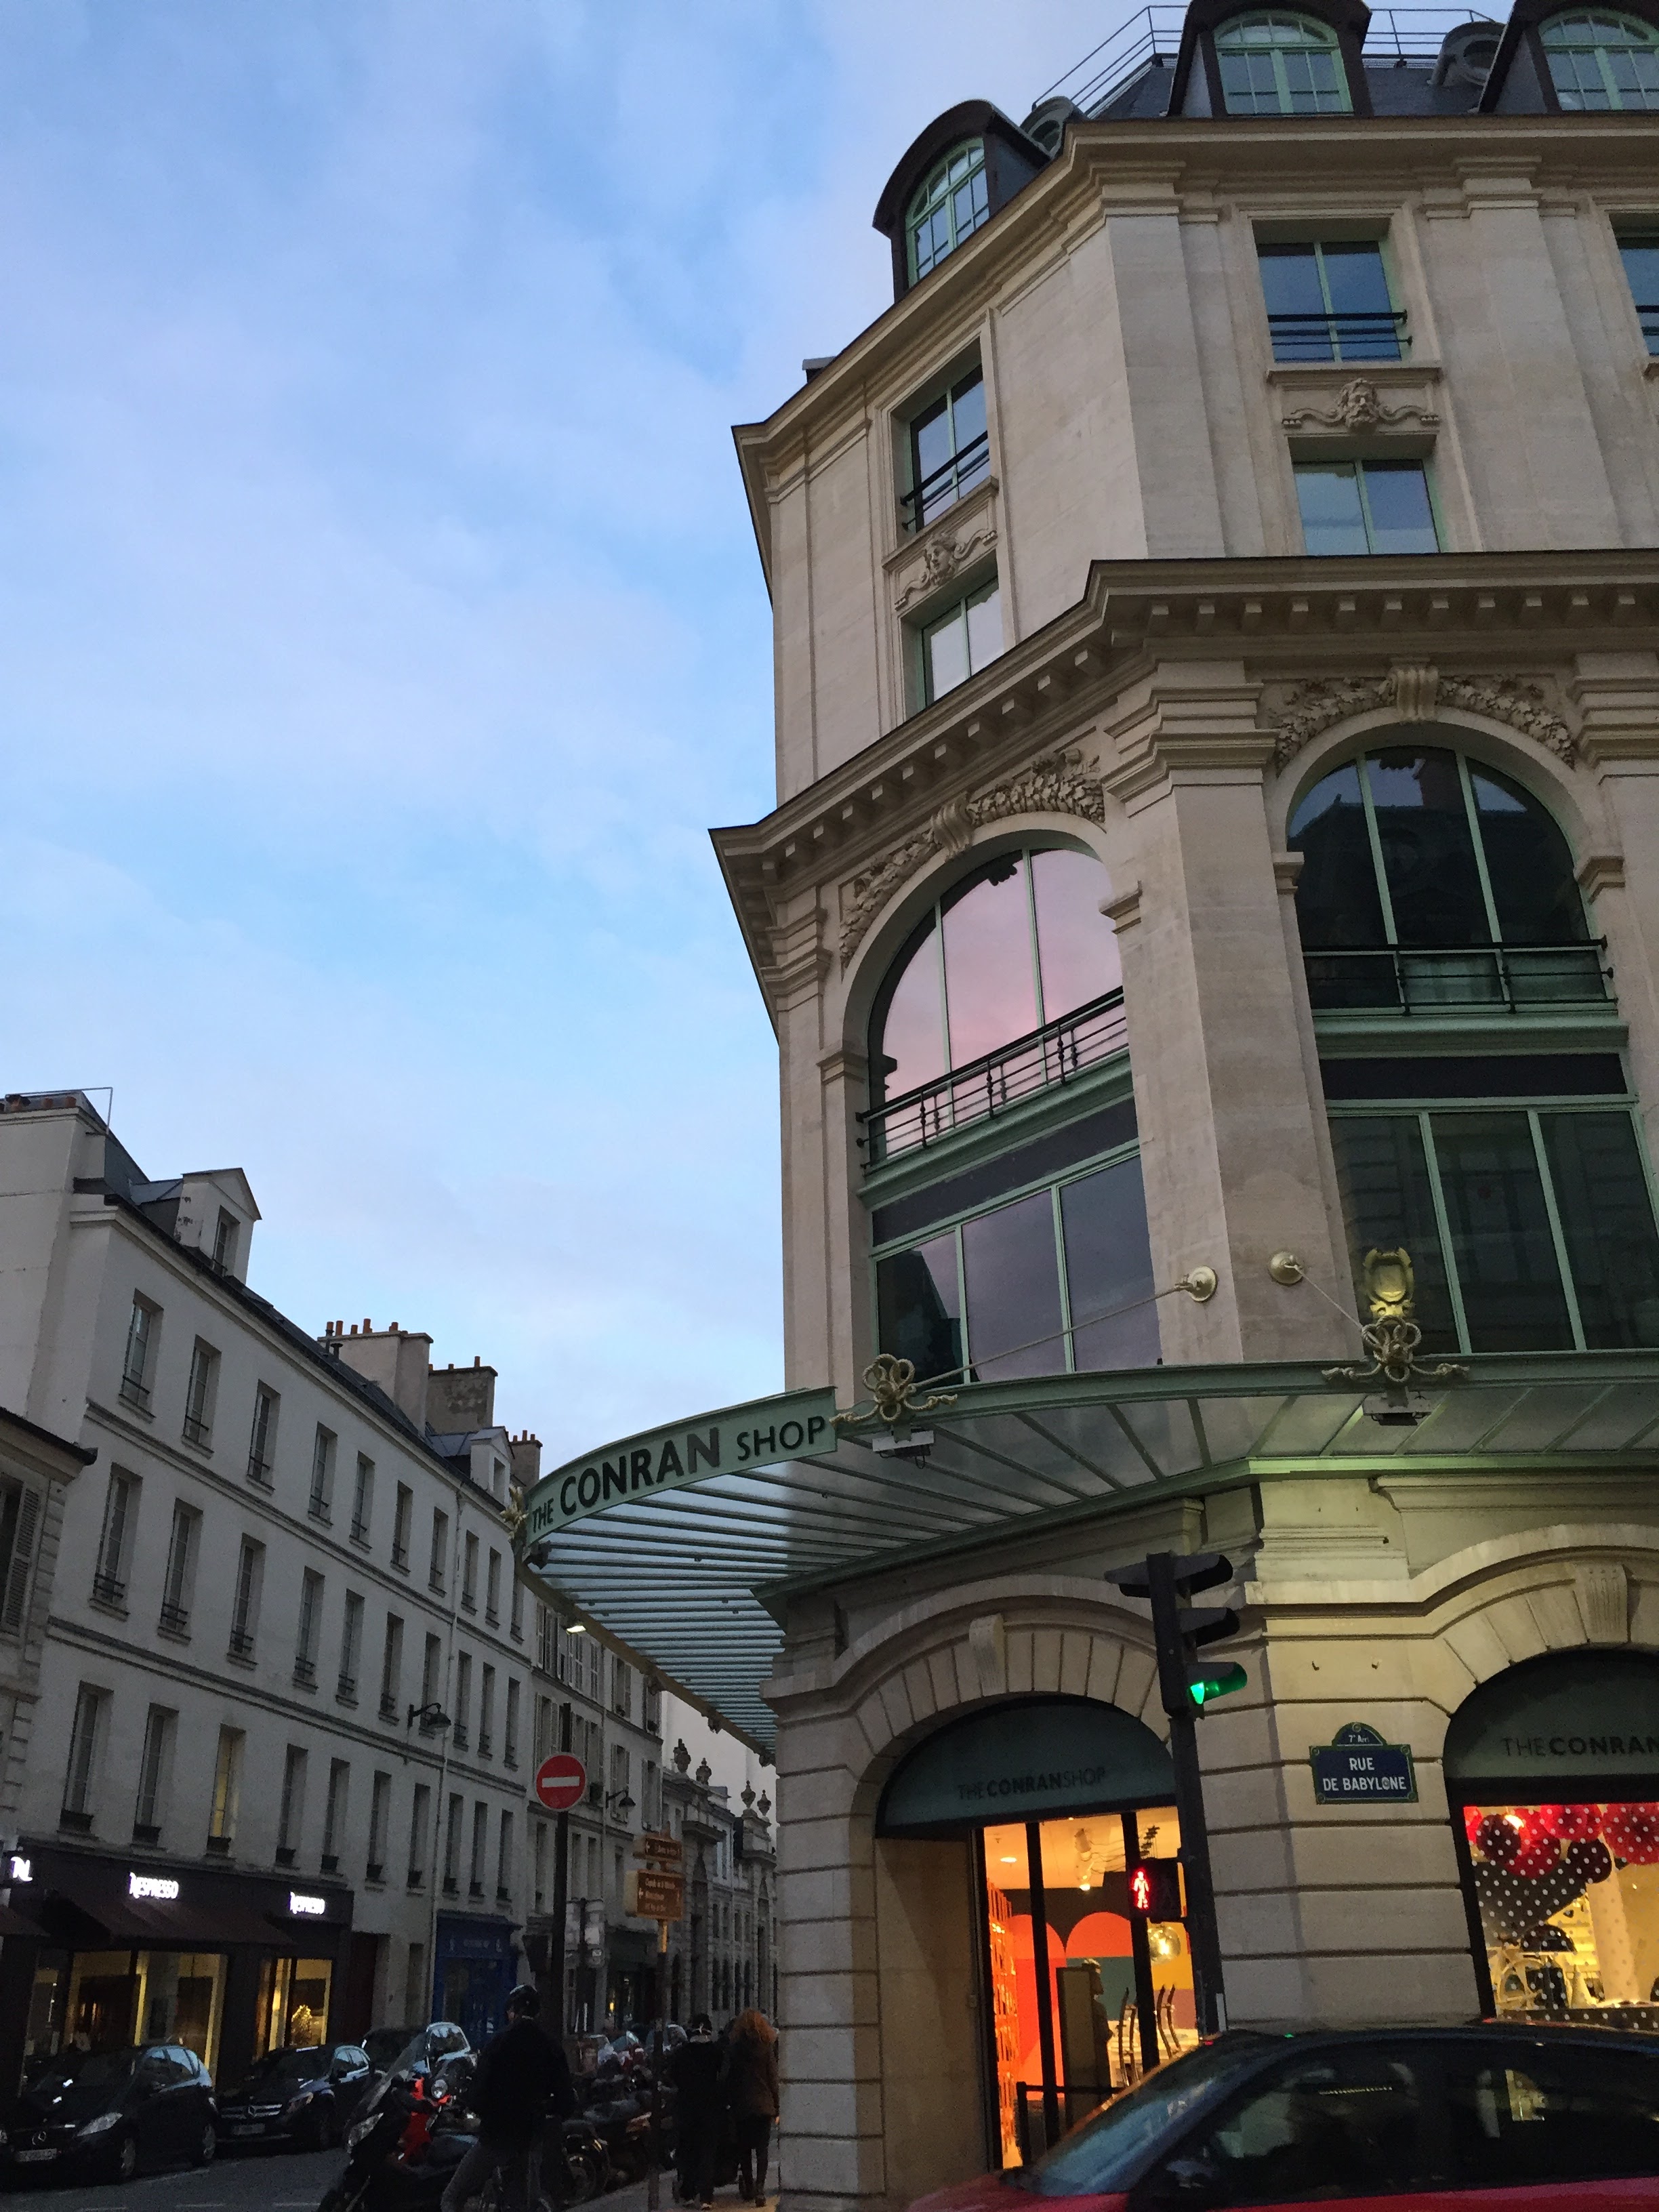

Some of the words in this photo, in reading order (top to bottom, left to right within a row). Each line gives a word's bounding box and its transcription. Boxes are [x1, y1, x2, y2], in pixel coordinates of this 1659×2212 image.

[533, 1498, 554, 1533] THE
[560, 1427, 720, 1516] CONRAN
[737, 1416, 825, 1461] SHOP
[1349, 1757, 1375, 1771] RUE
[1323, 1778, 1339, 1791] DE
[1343, 1776, 1407, 1791] BABYLONE
